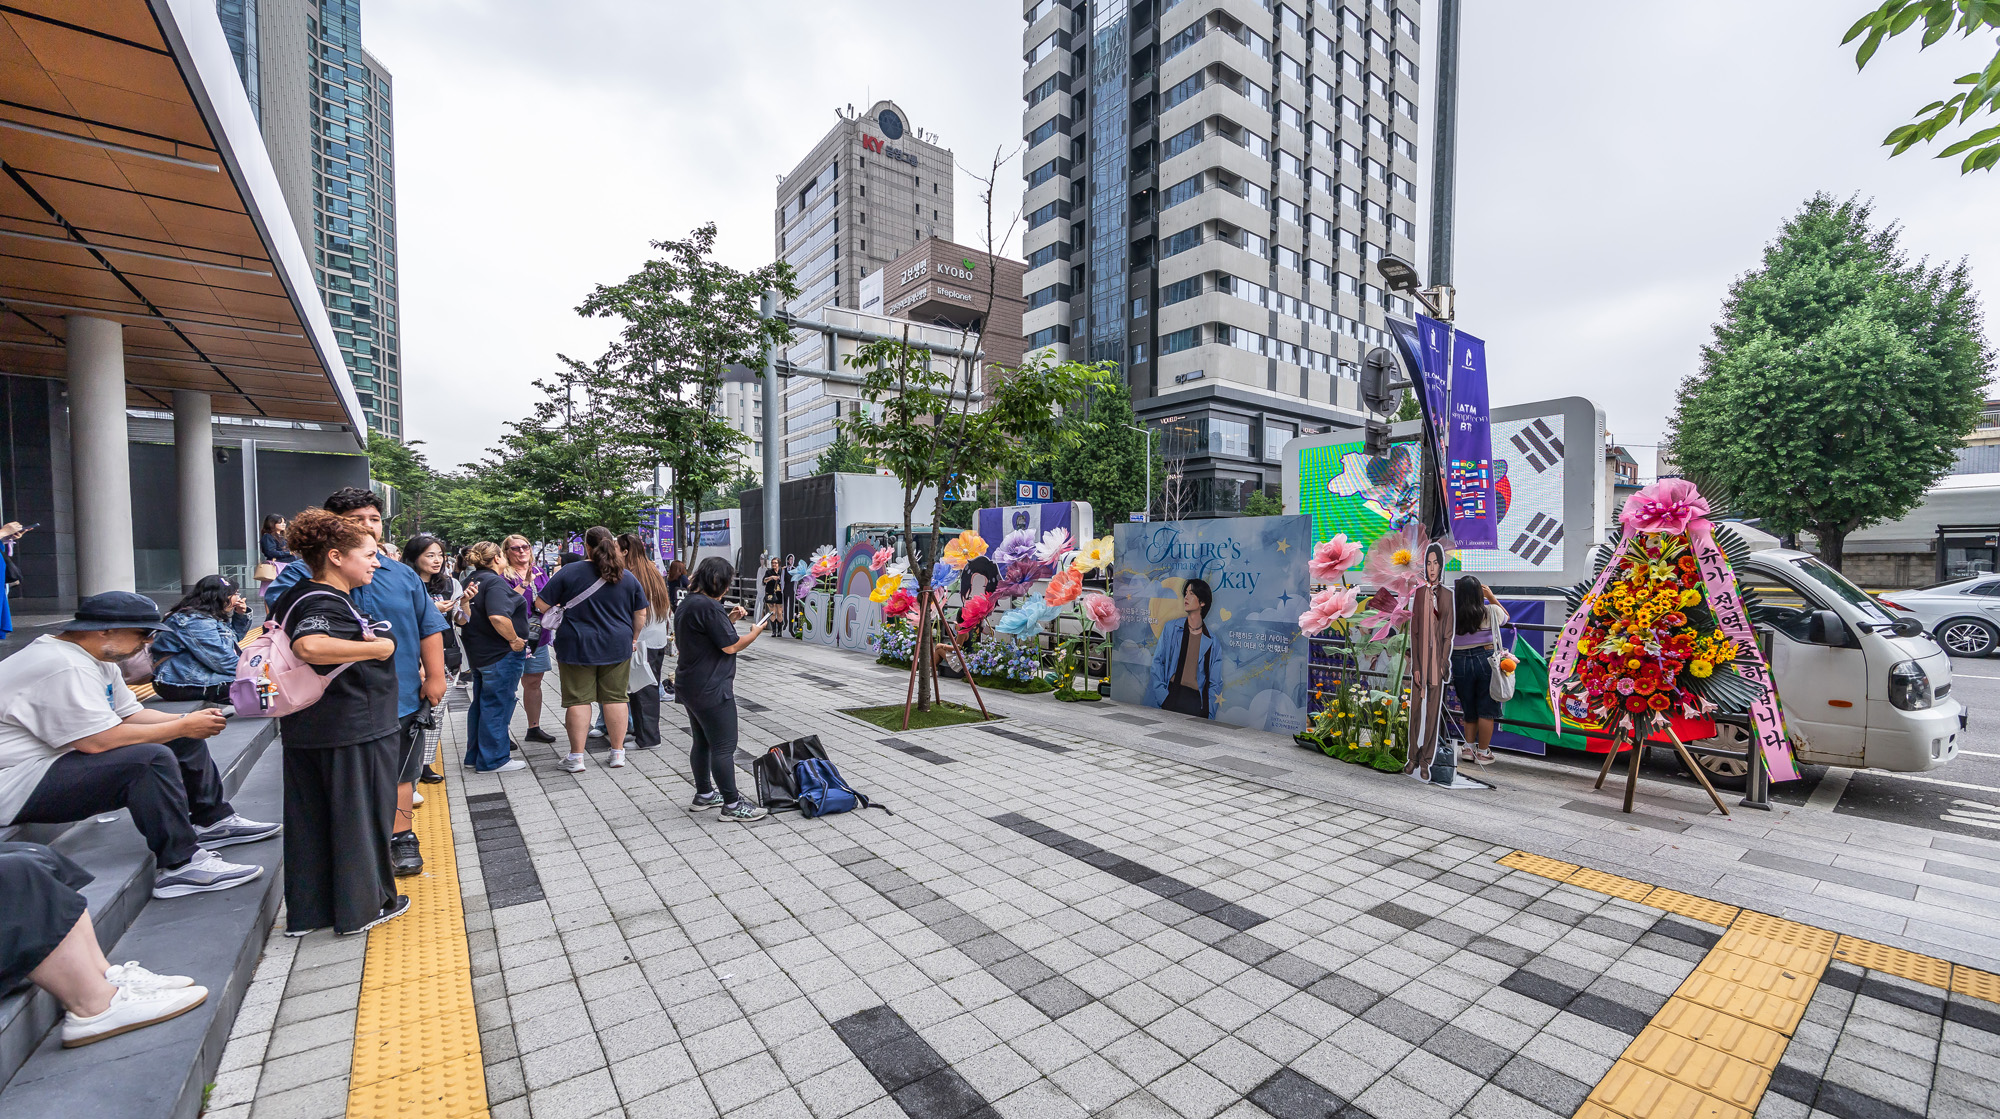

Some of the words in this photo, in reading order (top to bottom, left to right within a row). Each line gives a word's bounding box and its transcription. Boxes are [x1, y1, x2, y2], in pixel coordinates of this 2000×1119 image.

[862, 133, 885, 154] KY
[900, 258, 927, 286] 교보생명
[937, 263, 973, 281] KYOBO
[937, 286, 972, 302] lifeplanet
[1699, 547, 1729, 583] 슈가
[1714, 592, 1743, 632] 전역
[803, 591, 882, 653] SUGA
[1229, 640, 1242, 648] 아직
[1255, 632, 1267, 642] 우리
[1268, 634, 1289, 645] 사이는
